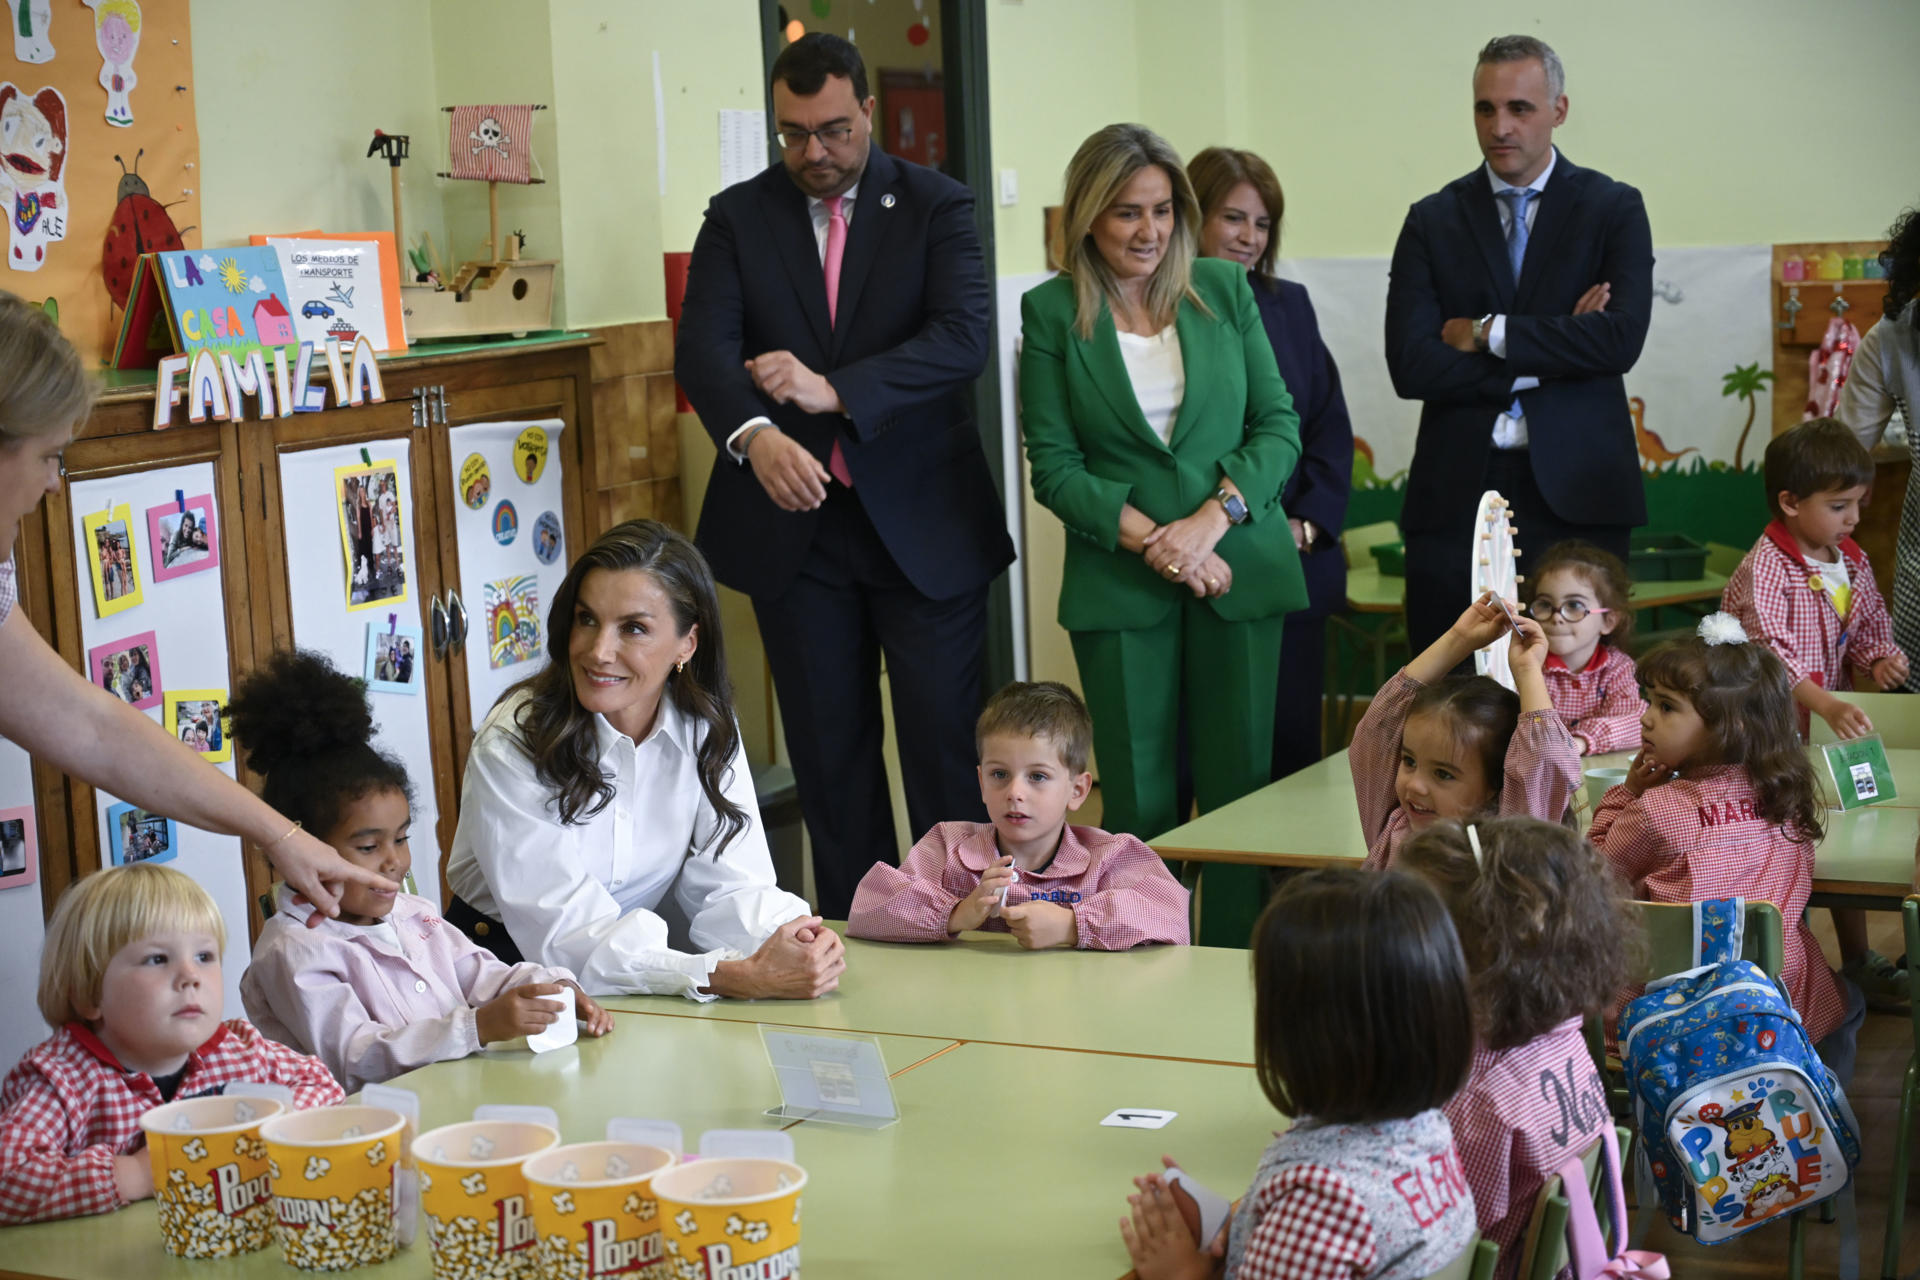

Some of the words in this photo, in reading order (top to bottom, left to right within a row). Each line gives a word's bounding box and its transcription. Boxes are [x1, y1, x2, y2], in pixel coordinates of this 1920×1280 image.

[167, 255, 204, 288] LA
[291, 254, 308, 263] LOS
[348, 256, 359, 264] DE
[182, 305, 245, 342] CASA
[153, 335, 386, 430] FAMILIA
[1031, 891, 1081, 903] PABLO
[1768, 1089, 1822, 1187] RULE
[1680, 1126, 1744, 1223] PUPS
